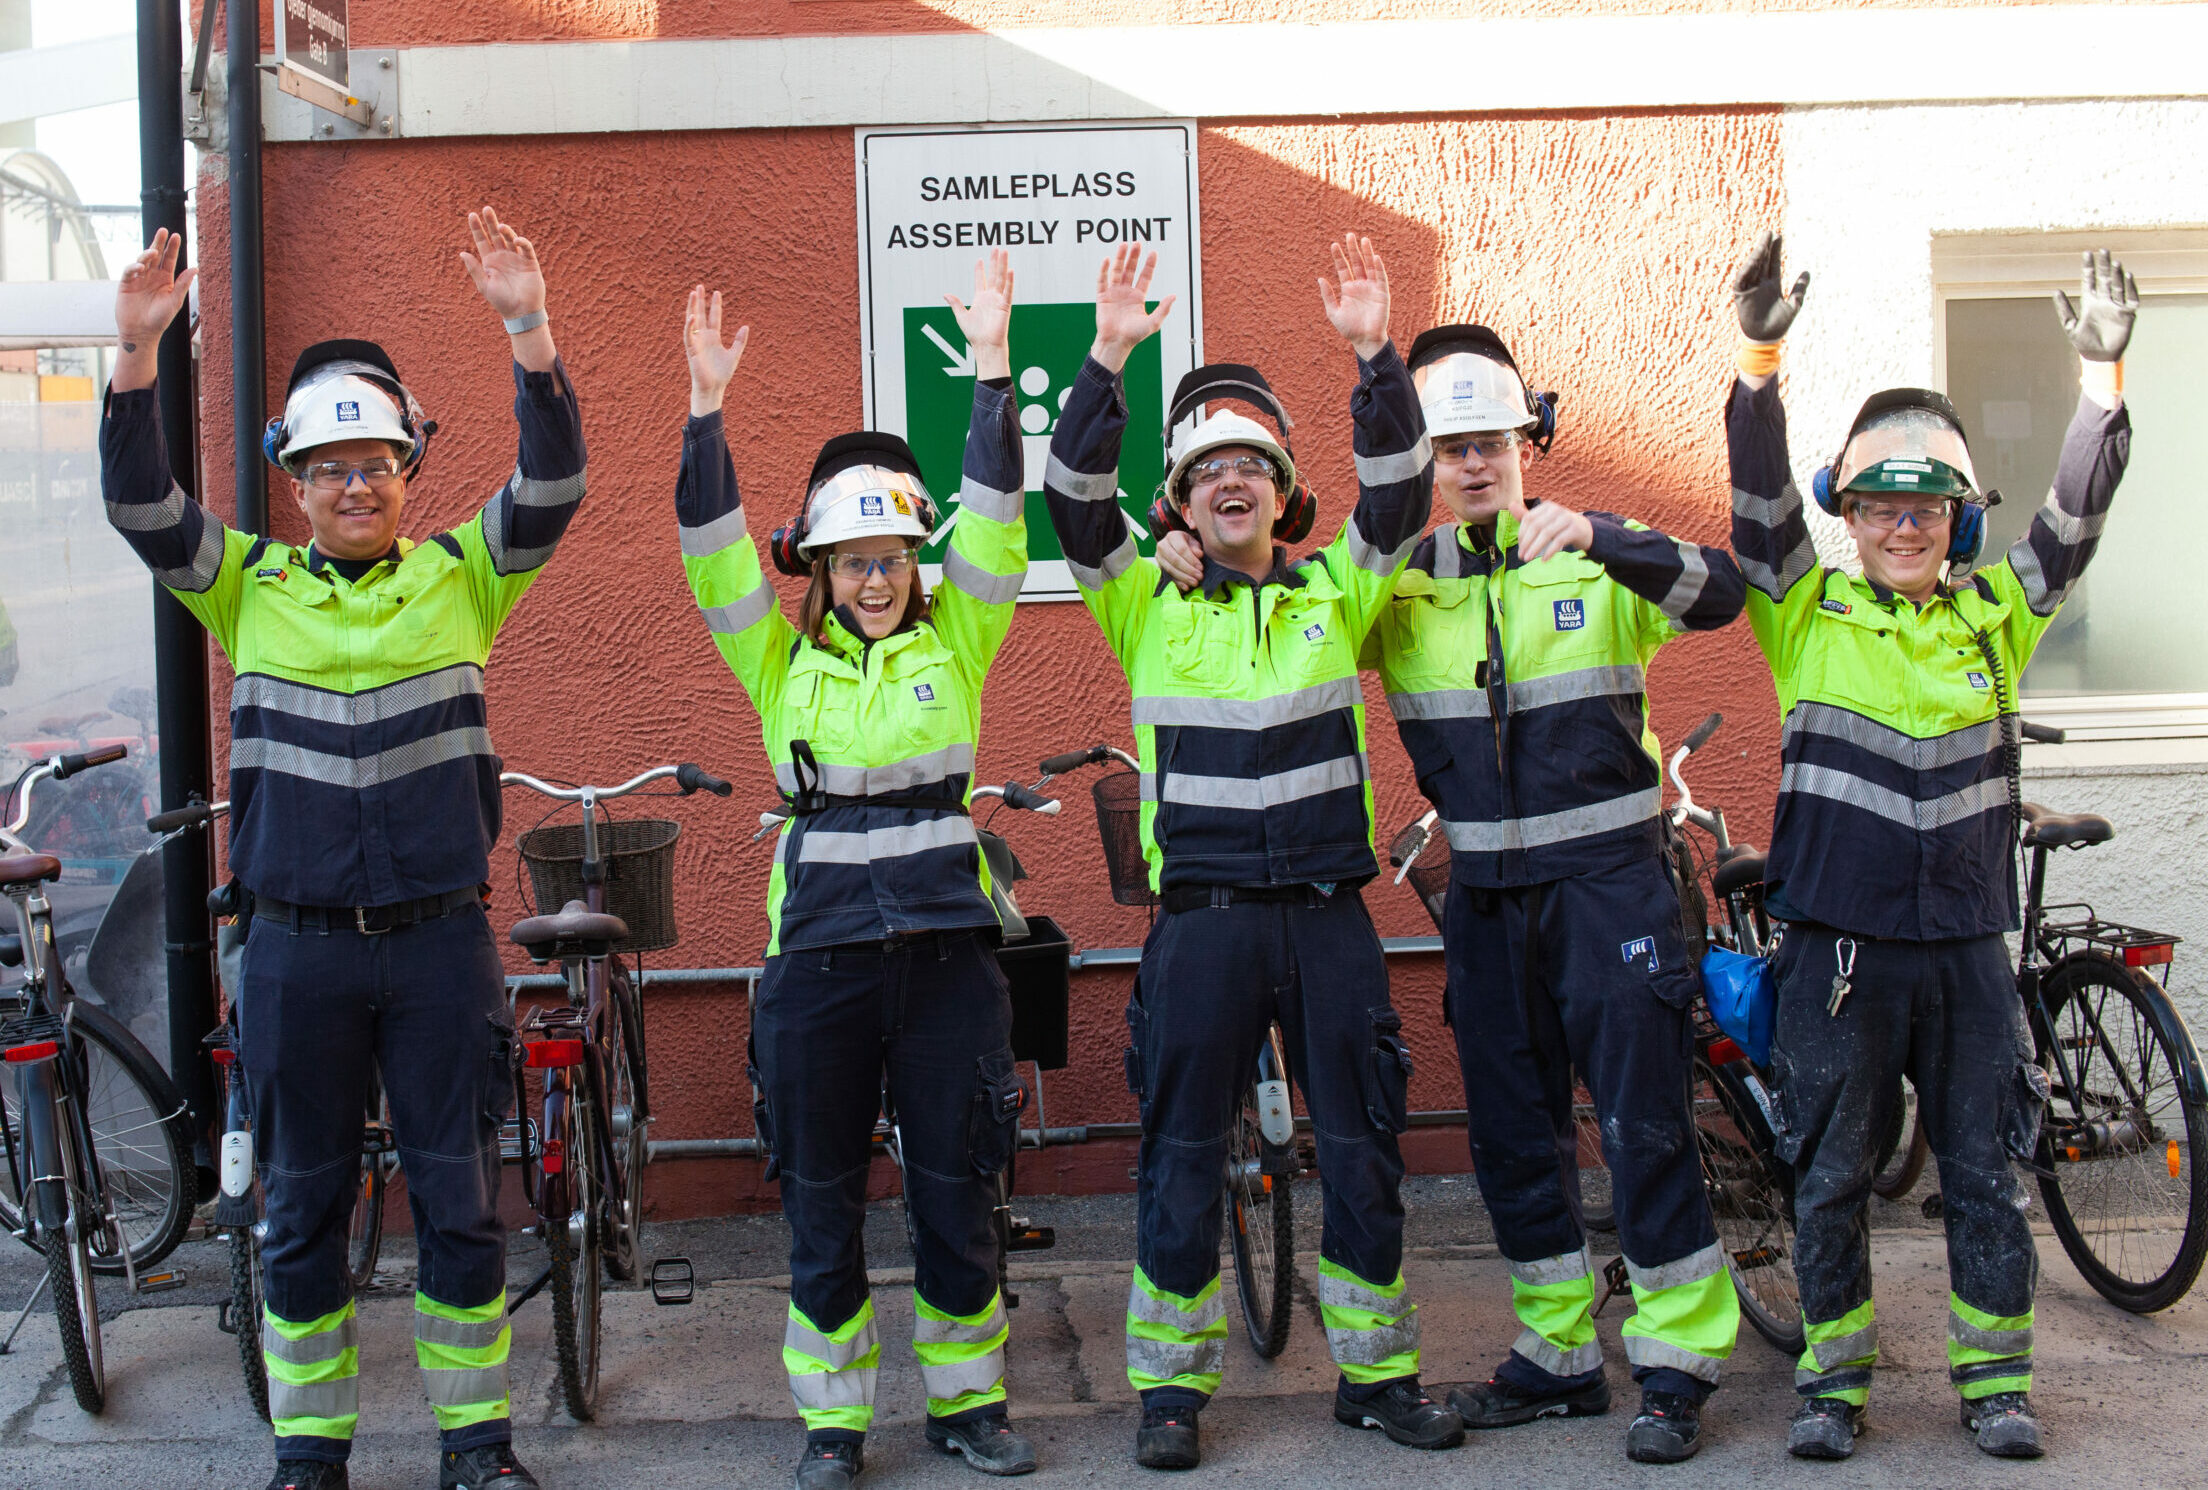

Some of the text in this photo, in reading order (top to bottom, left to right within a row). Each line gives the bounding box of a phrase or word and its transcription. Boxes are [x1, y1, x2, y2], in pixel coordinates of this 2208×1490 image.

[310, 34, 322, 63] Gate
[920, 171, 1136, 202] SAMLEPLASS
[887, 217, 1172, 249] ASSEMBLY POINT
[1558, 620, 1582, 628] YARA
